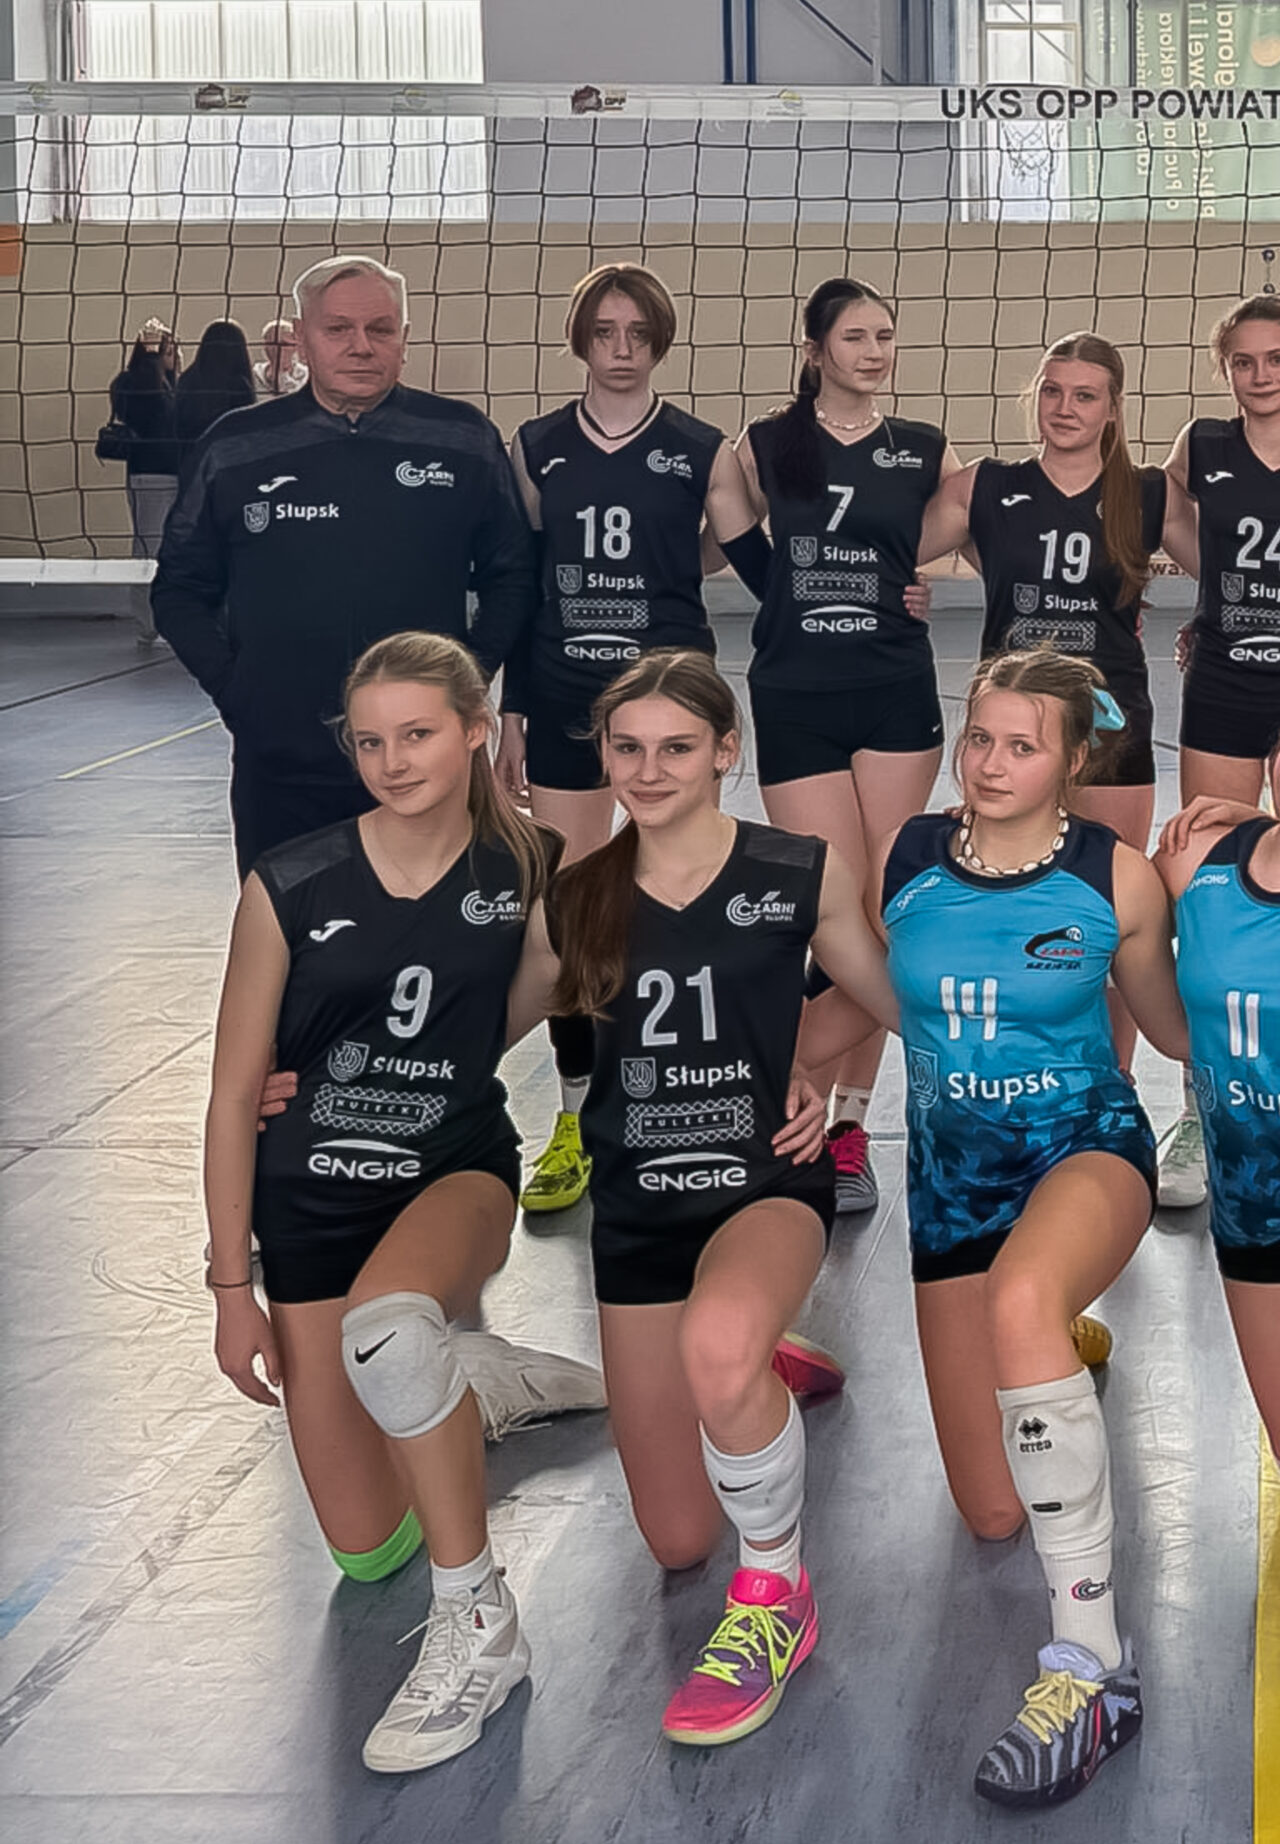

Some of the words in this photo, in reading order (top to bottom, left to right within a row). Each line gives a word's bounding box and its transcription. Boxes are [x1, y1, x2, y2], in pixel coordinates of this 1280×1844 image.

[941, 88, 1021, 119] UKS
[1036, 88, 1118, 119] OPP
[275, 502, 340, 521] Słupsk
[826, 484, 855, 532] 7
[576, 505, 631, 560] 18
[1039, 529, 1092, 584] 19
[587, 572, 646, 592] Słupsk
[386, 964, 433, 1039] 9
[637, 965, 718, 1047] 21
[1226, 990, 1260, 1058] 11
[369, 1055, 456, 1082] Słupsk
[665, 1059, 753, 1088] Słupsk
[948, 1067, 1062, 1105] Słupsk
